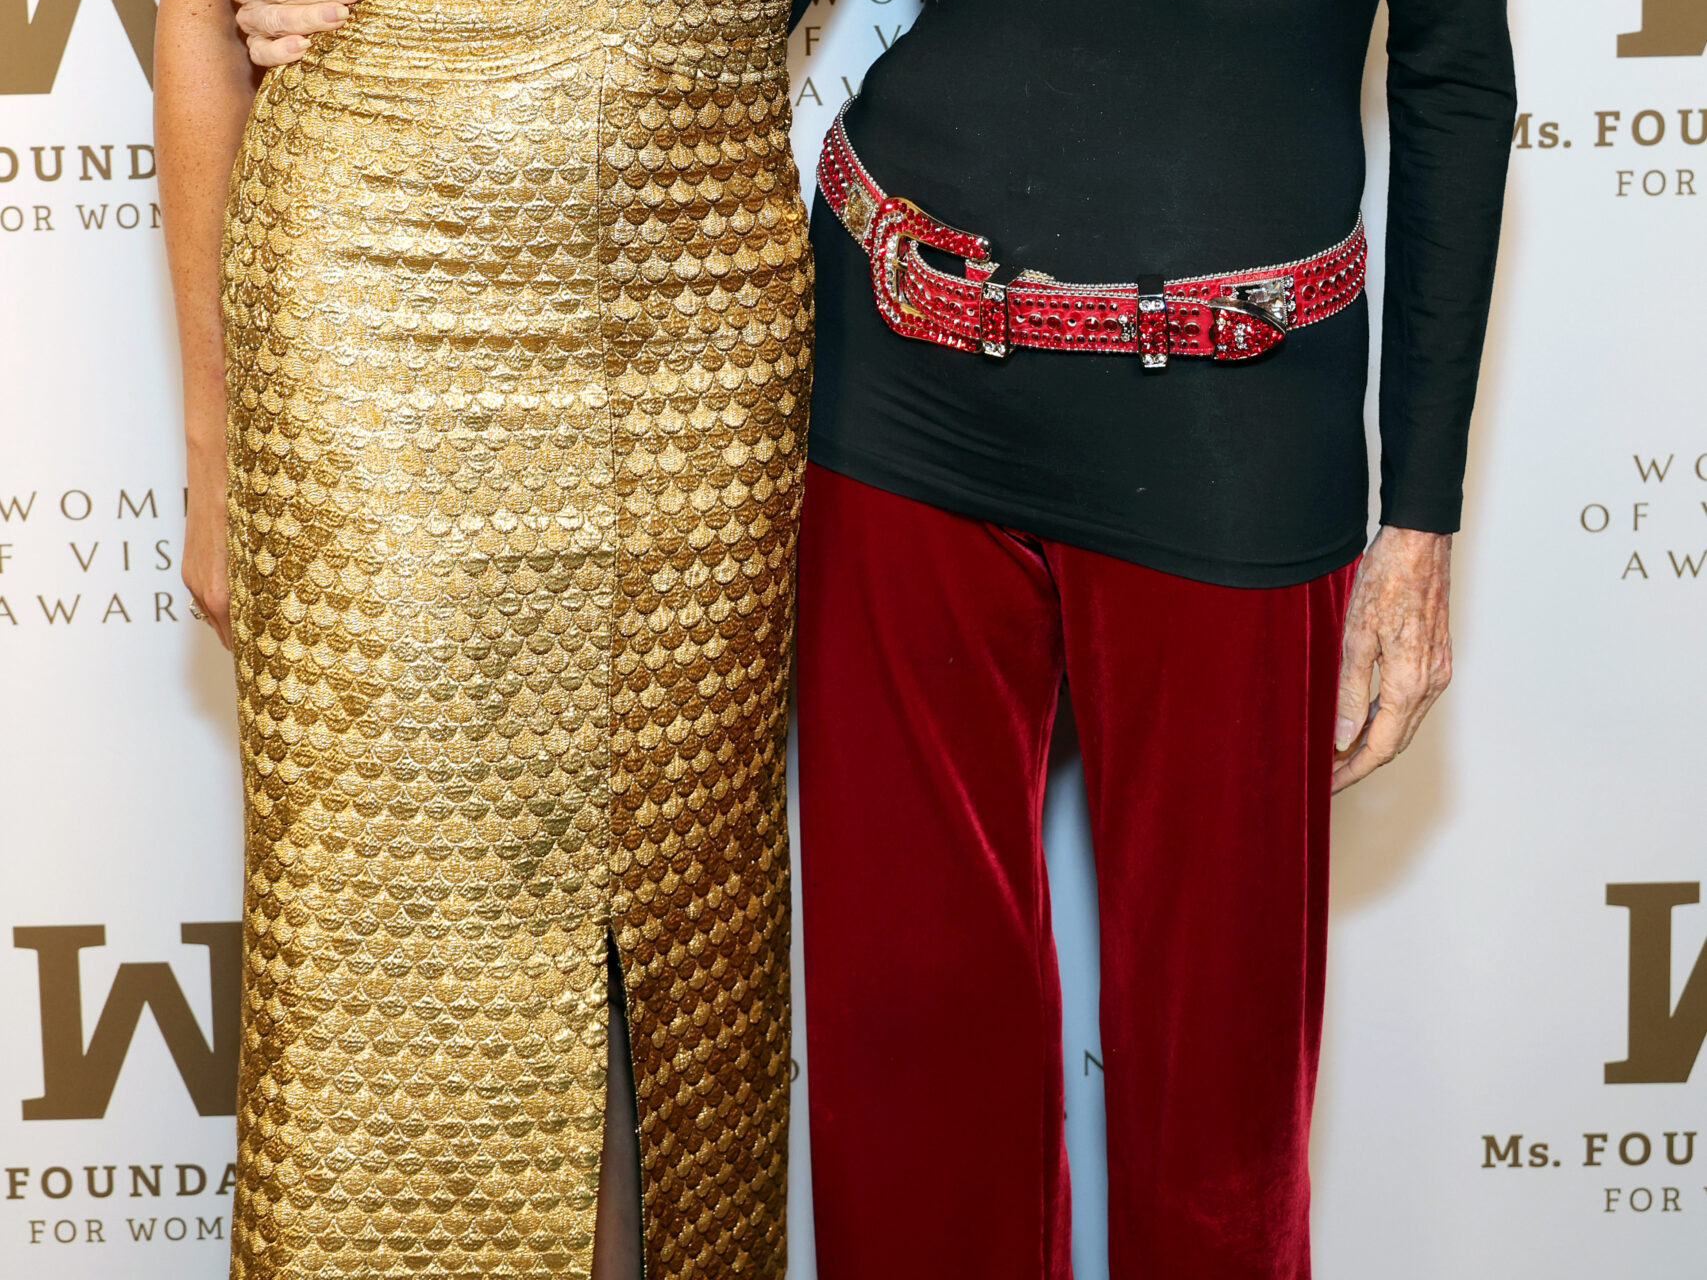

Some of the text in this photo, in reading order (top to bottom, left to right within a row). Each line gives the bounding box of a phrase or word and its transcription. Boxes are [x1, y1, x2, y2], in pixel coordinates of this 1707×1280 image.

[1616, 169, 1697, 197] FOR
[0, 486, 189, 522] WOM
[1580, 502, 1649, 533] OF
[1480, 1131, 1698, 1169] Ms. FOU
[1603, 1186, 1683, 1213] FOR
[28, 1219, 107, 1245] FOR
